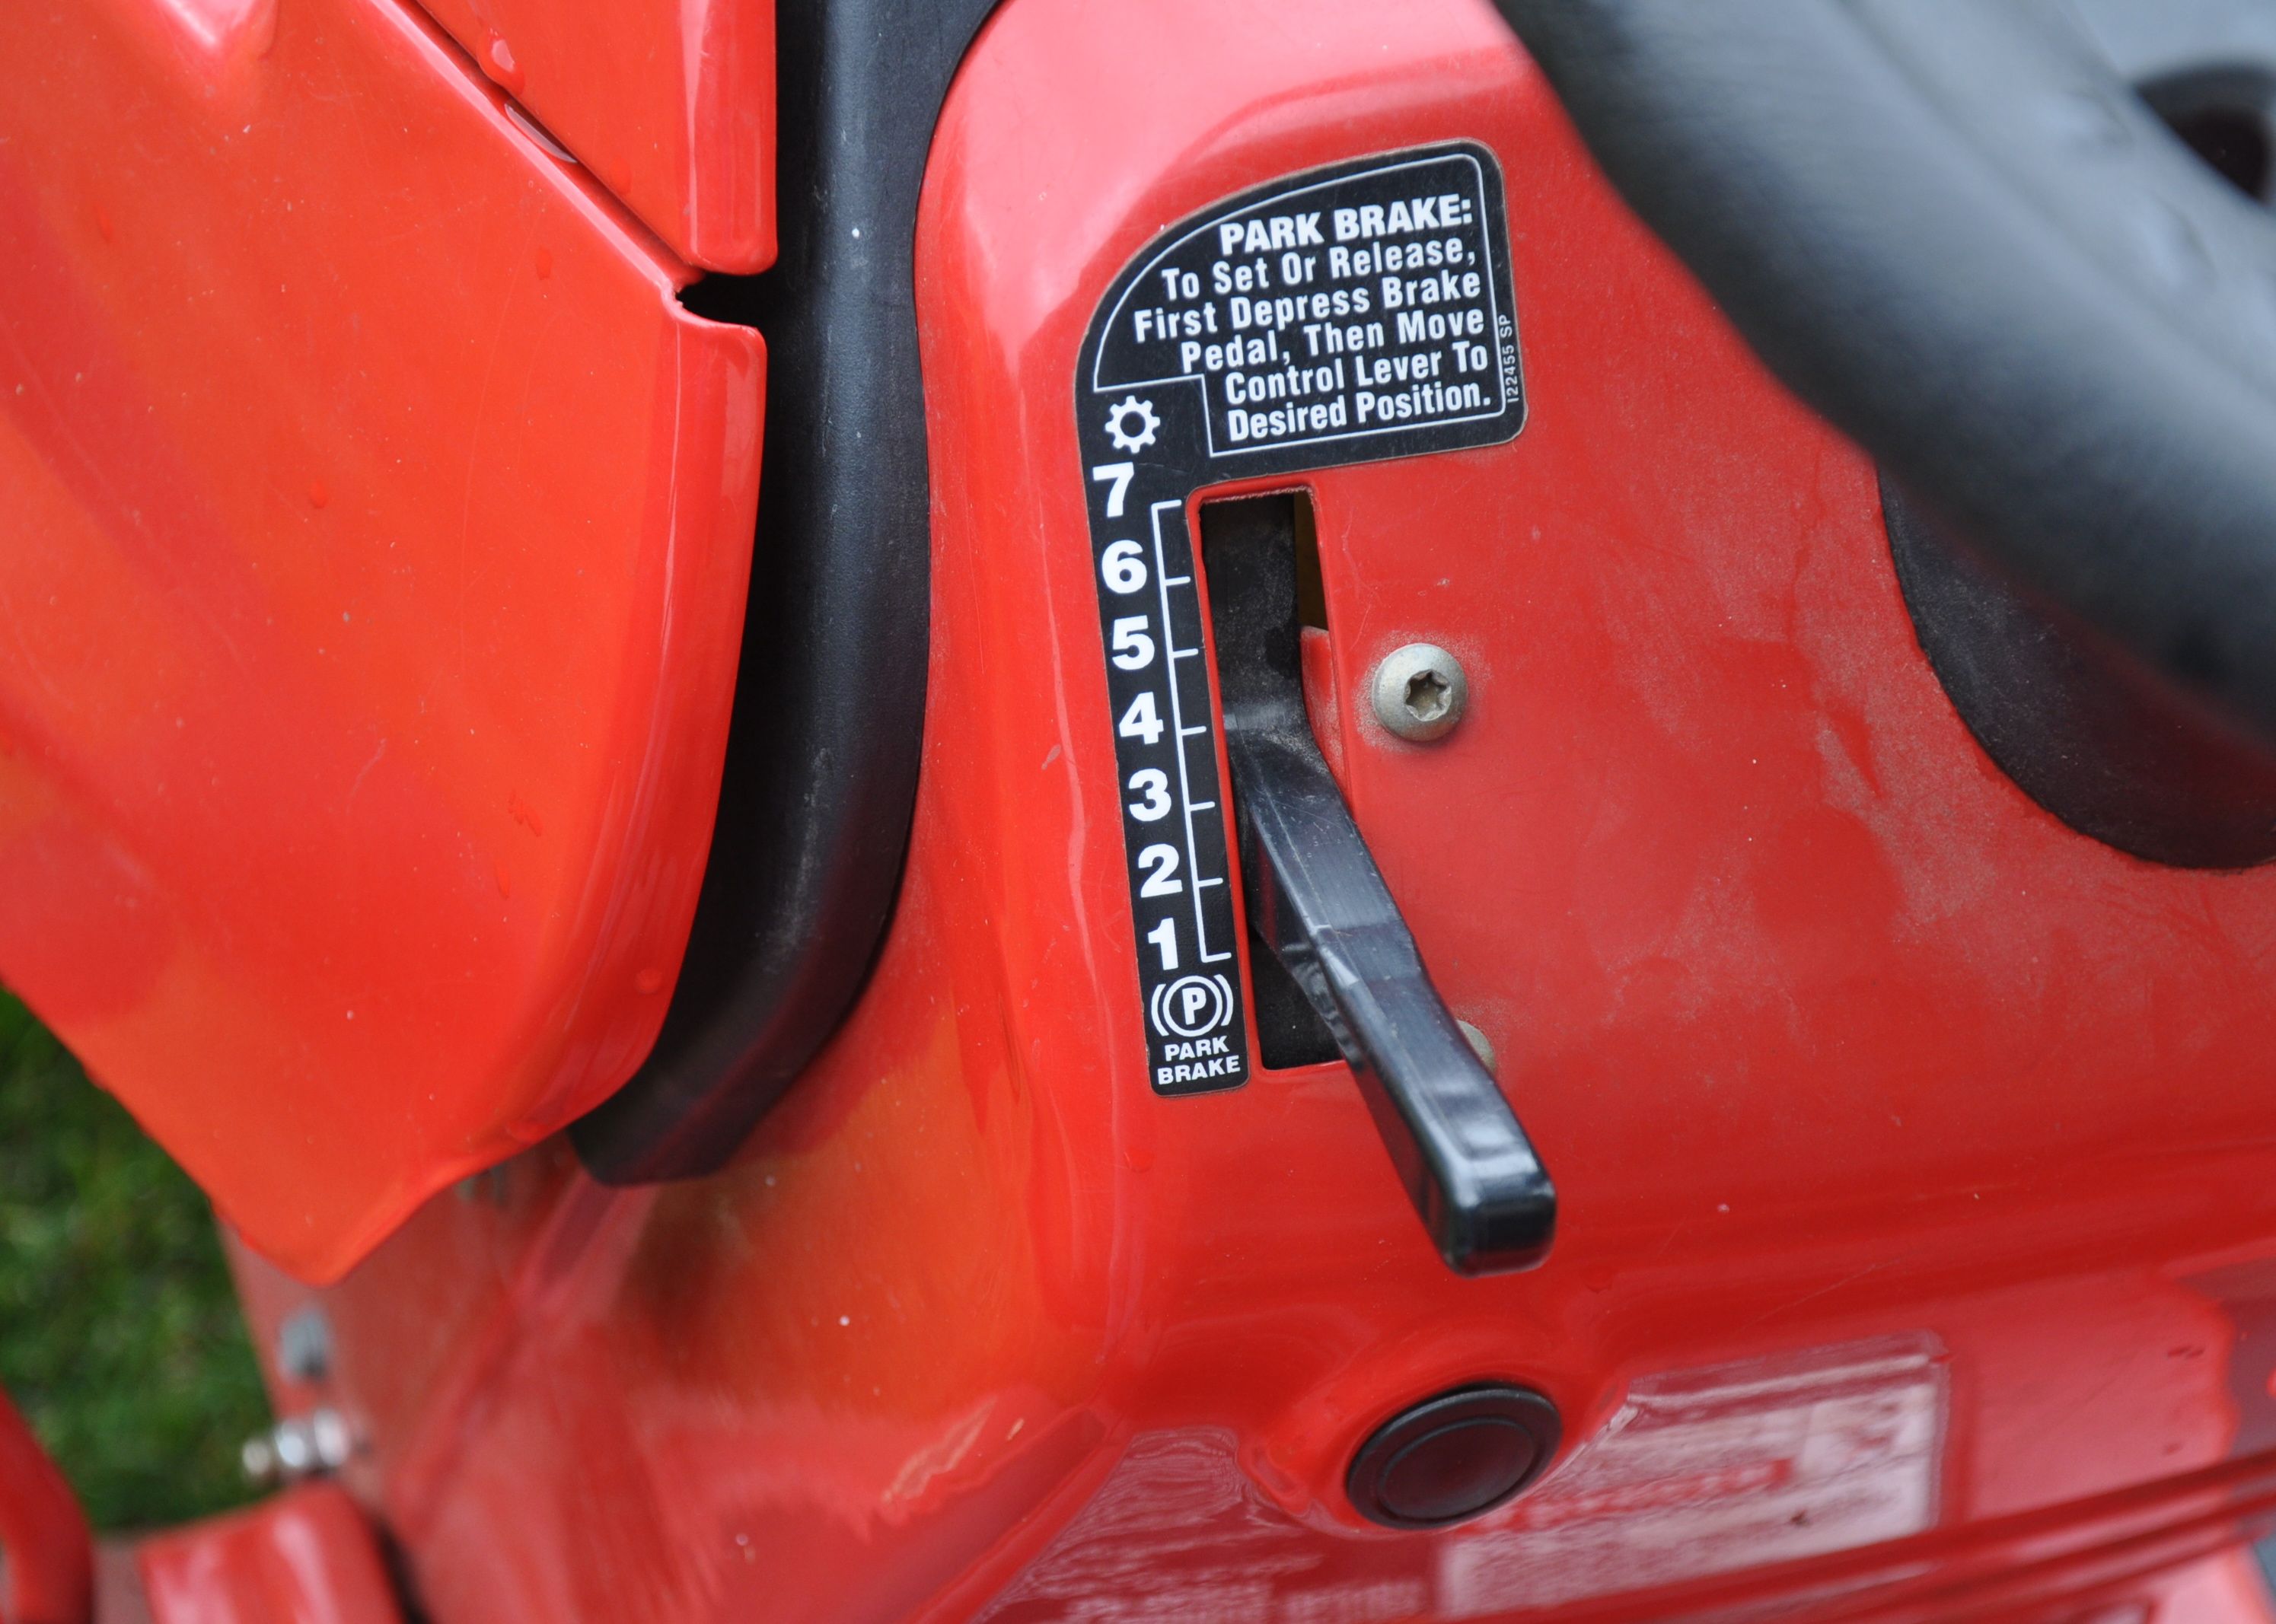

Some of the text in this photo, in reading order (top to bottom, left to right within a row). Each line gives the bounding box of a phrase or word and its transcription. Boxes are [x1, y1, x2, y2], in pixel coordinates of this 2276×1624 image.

[1219, 193, 1473, 256] PARK BRAKE:
[1161, 237, 1475, 301] To Set Or Release,
[1134, 269, 1481, 343] First Depress Brake
[1498, 314, 1513, 339] SP
[1181, 309, 1484, 374] Pedal, Then Move
[1225, 340, 1488, 406] Control Lever To
[1227, 381, 1491, 442] Desired Position.
[1092, 461, 1135, 518] 7
[1101, 540, 1148, 594] 6
[1111, 614, 1156, 670] 5
[1118, 691, 1165, 745] 4
[1128, 768, 1172, 822] 3
[1138, 843, 1183, 898] 2
[1147, 917, 1179, 971] 1
[1157, 1055, 1241, 1085] BRAKE
[1164, 1035, 1230, 1062] PARK
